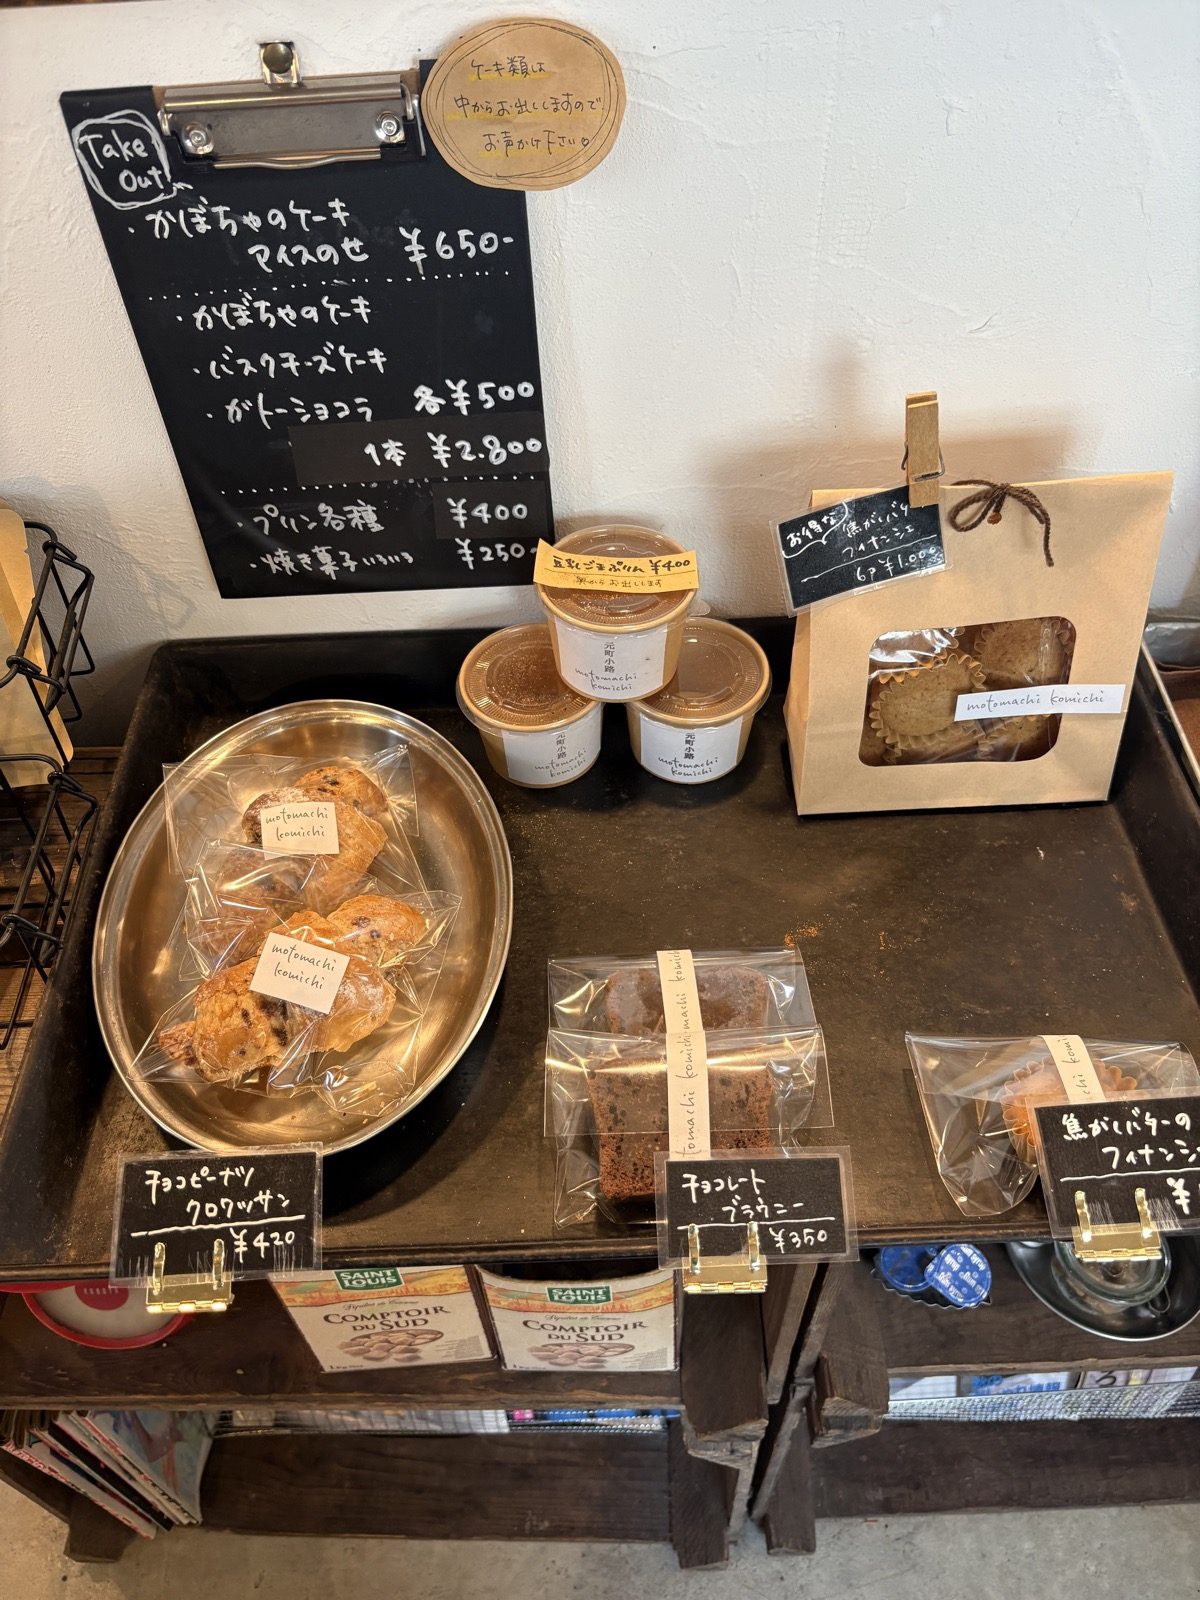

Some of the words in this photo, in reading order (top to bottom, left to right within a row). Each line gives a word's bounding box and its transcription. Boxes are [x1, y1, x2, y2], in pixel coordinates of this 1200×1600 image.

[471, 56, 546, 80] ケーキ類は
[454, 93, 602, 118] 中からお出ししますので
[79, 129, 149, 169] Take
[119, 166, 164, 192] Out
[145, 196, 350, 239] かぼちゃのケーキ
[248, 236, 369, 273] アイスのせ
[192, 292, 371, 330] かぼちゃのケーキ
[209, 341, 388, 379] バスクチーズケーキ
[364, 439, 407, 466] 1本
[253, 500, 385, 535] プリン各種
[447, 498, 528, 528] ¥400
[260, 544, 414, 580] 焼き菓子いろいろ
[650, 559, 690, 574] ¥400
[603, 641, 616, 673] 元町小路
[575, 667, 637, 682] motomachi
[591, 682, 633, 691] komichi
[967, 694, 1041, 712] motomachi
[1050, 689, 1104, 705] komichi
[556, 732, 567, 759] 元町小路
[684, 732, 696, 760] 元町小路
[534, 748, 587, 771] motomachi
[550, 758, 587, 778] komichi
[658, 757, 719, 771] motomachi
[671, 767, 712, 777] komichi
[265, 808, 328, 824] motomachi
[276, 825, 325, 841] komichi
[272, 944, 337, 972] motomachi
[274, 962, 325, 990] komichi
[1062, 1106, 1191, 1140] 焦がしバターの
[681, 1168, 766, 1203] チョコレート
[186, 1190, 290, 1226] クロワッサン
[722, 1194, 805, 1222] ブラウニー
[229, 1227, 296, 1263] ¥420
[769, 1227, 828, 1253] ¥350
[340, 1269, 395, 1280] SAINT
[343, 1275, 398, 1288] LOUIS
[552, 1287, 605, 1295] SAINT
[553, 1294, 607, 1302] LOUIS
